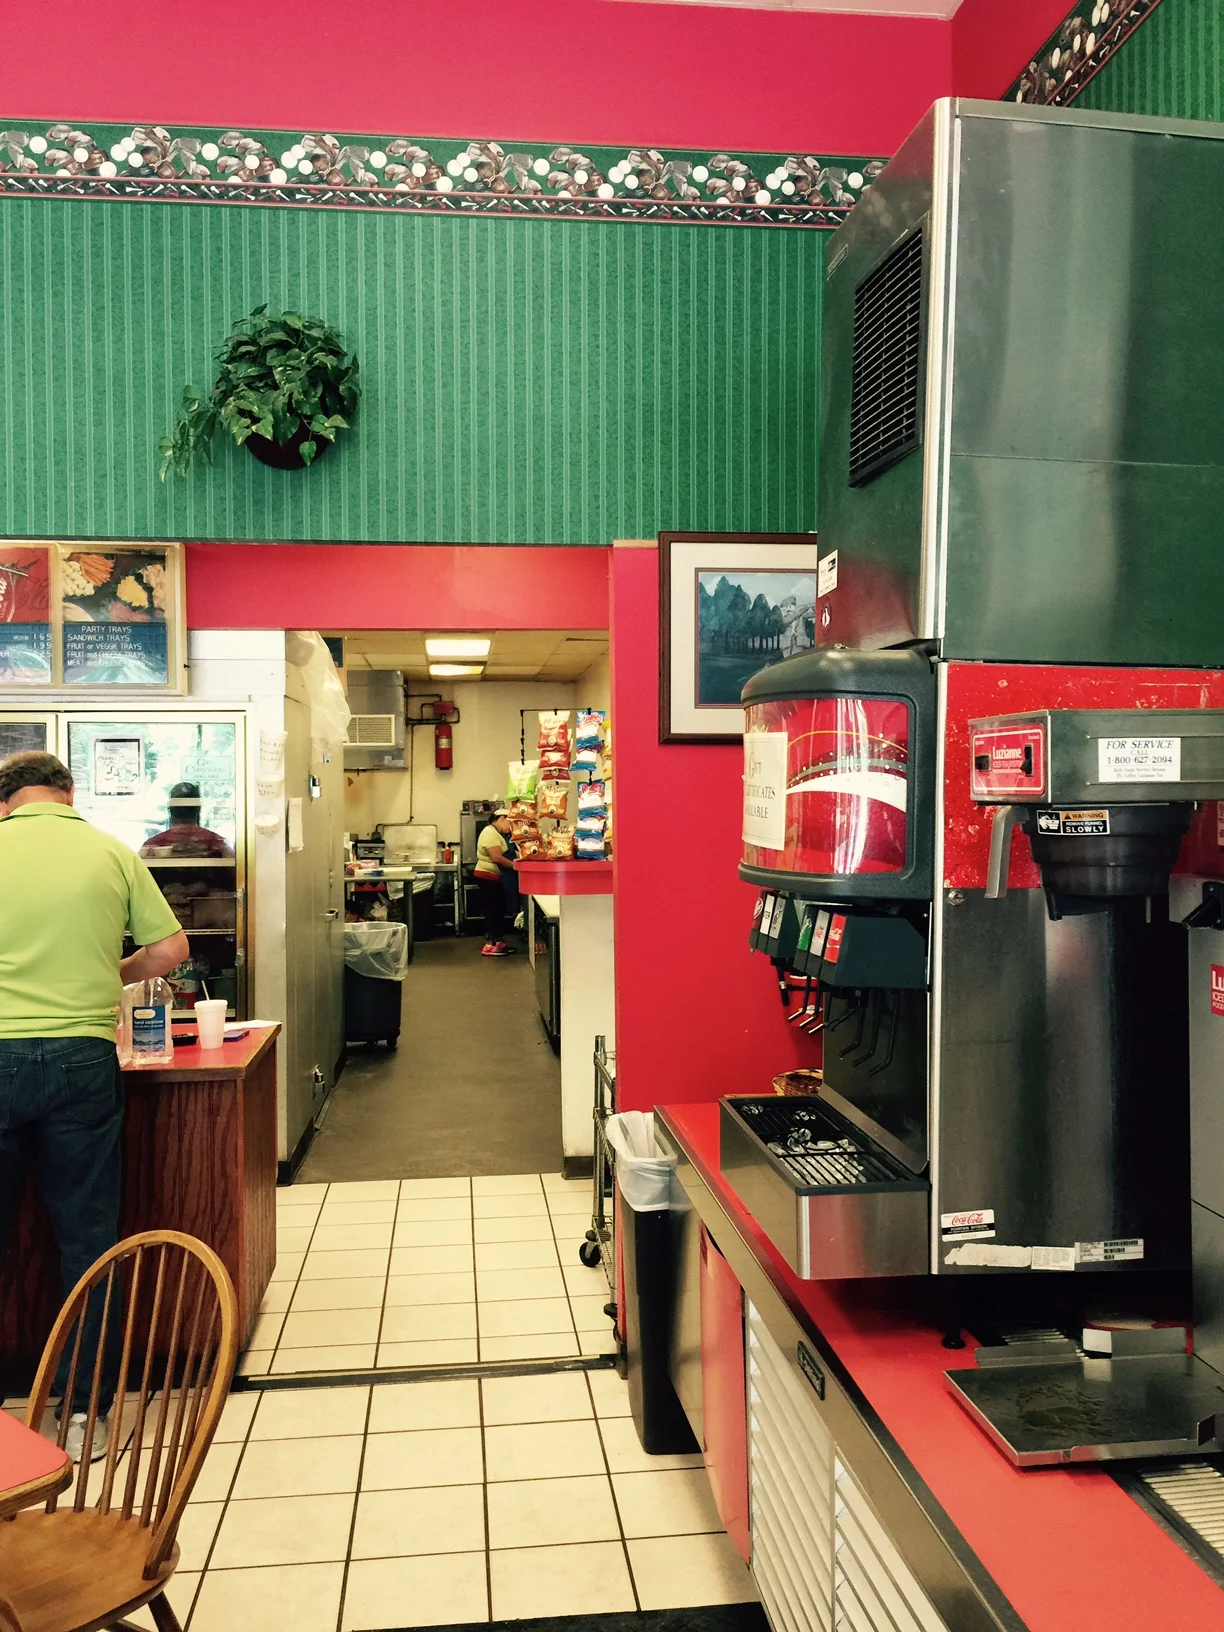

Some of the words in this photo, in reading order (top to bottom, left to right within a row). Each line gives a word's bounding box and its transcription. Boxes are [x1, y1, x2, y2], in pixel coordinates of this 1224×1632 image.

[81, 625, 106, 633] PARTY
[108, 625, 132, 634] TRAYS
[67, 633, 104, 641] SANDWICH
[106, 634, 130, 642] TRAYS
[66, 642, 84, 650] FRUIT
[95, 642, 118, 650] VEGGIE
[120, 642, 142, 651] TRAYS
[1106, 739, 1128, 750] FOR
[1130, 739, 1174, 749] SERVICE
[992, 744, 1022, 760] Luzianne
[1065, 825, 1105, 833] SLOWLY
